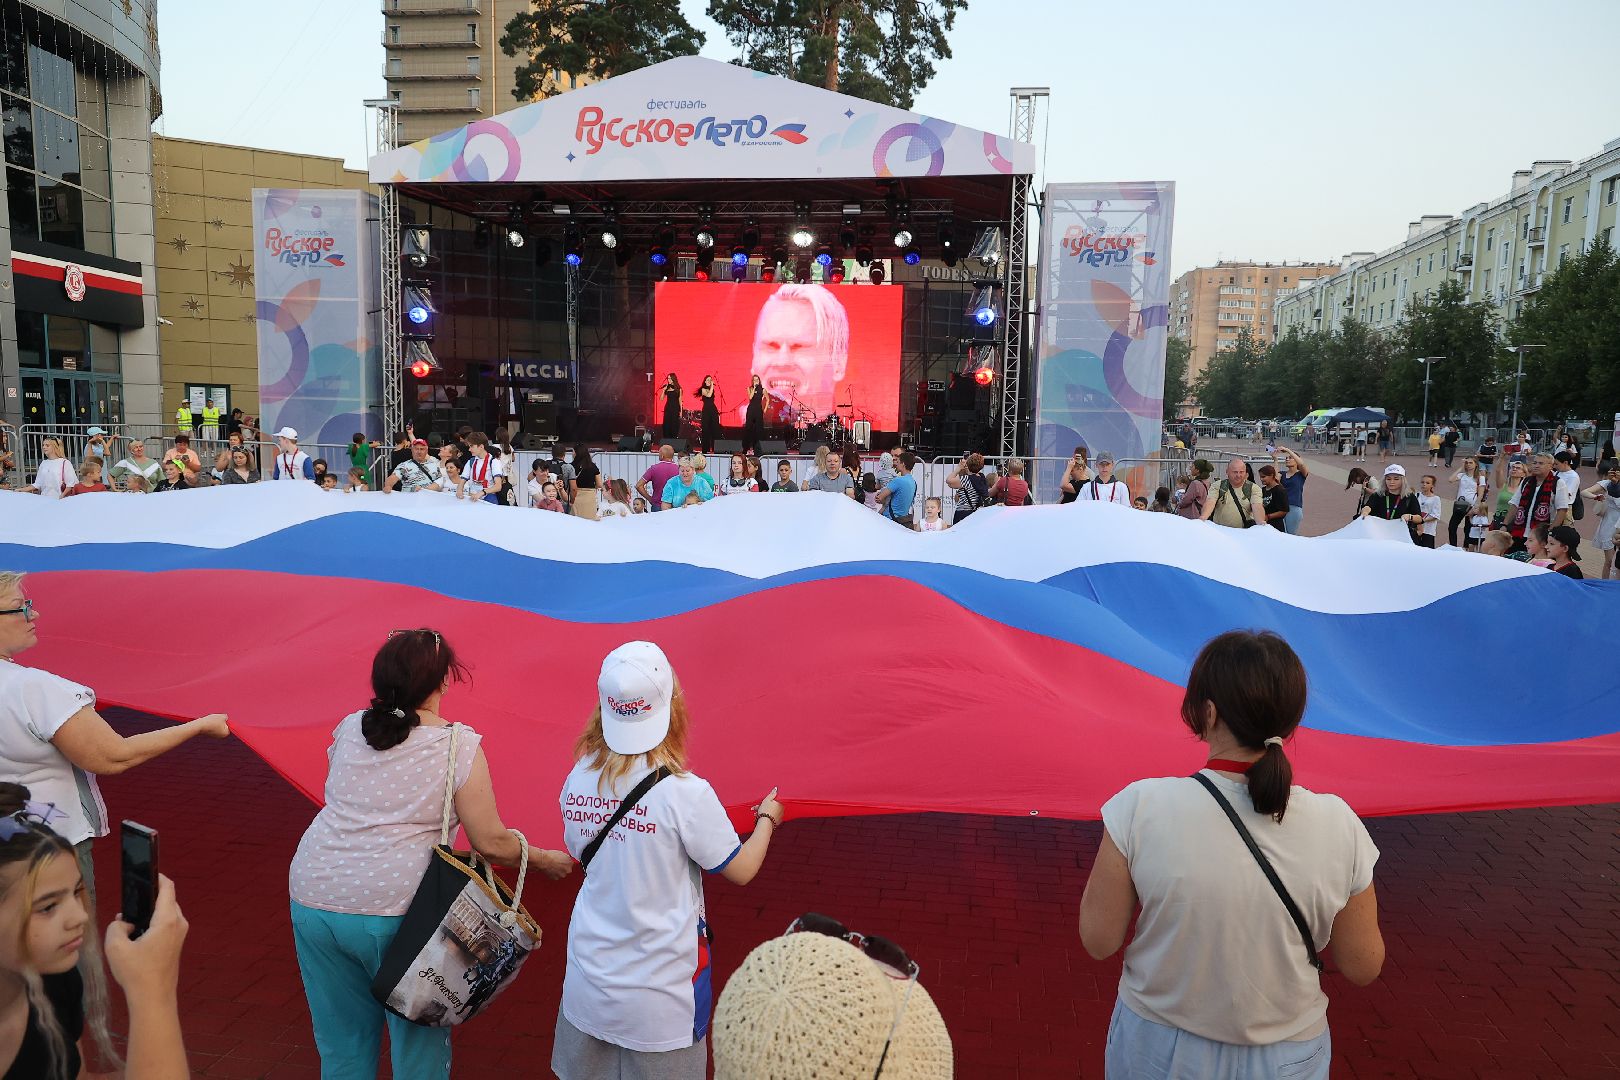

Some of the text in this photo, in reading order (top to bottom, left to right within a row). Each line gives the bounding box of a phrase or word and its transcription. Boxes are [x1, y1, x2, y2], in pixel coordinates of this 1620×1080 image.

[646, 98, 707, 112] фестиваль
[265, 227, 335, 257] Русское
[921, 265, 970, 281] TODES
[499, 363, 568, 379] КАССЫ
[563, 809, 656, 834] ОДМОСОВЬЯ
